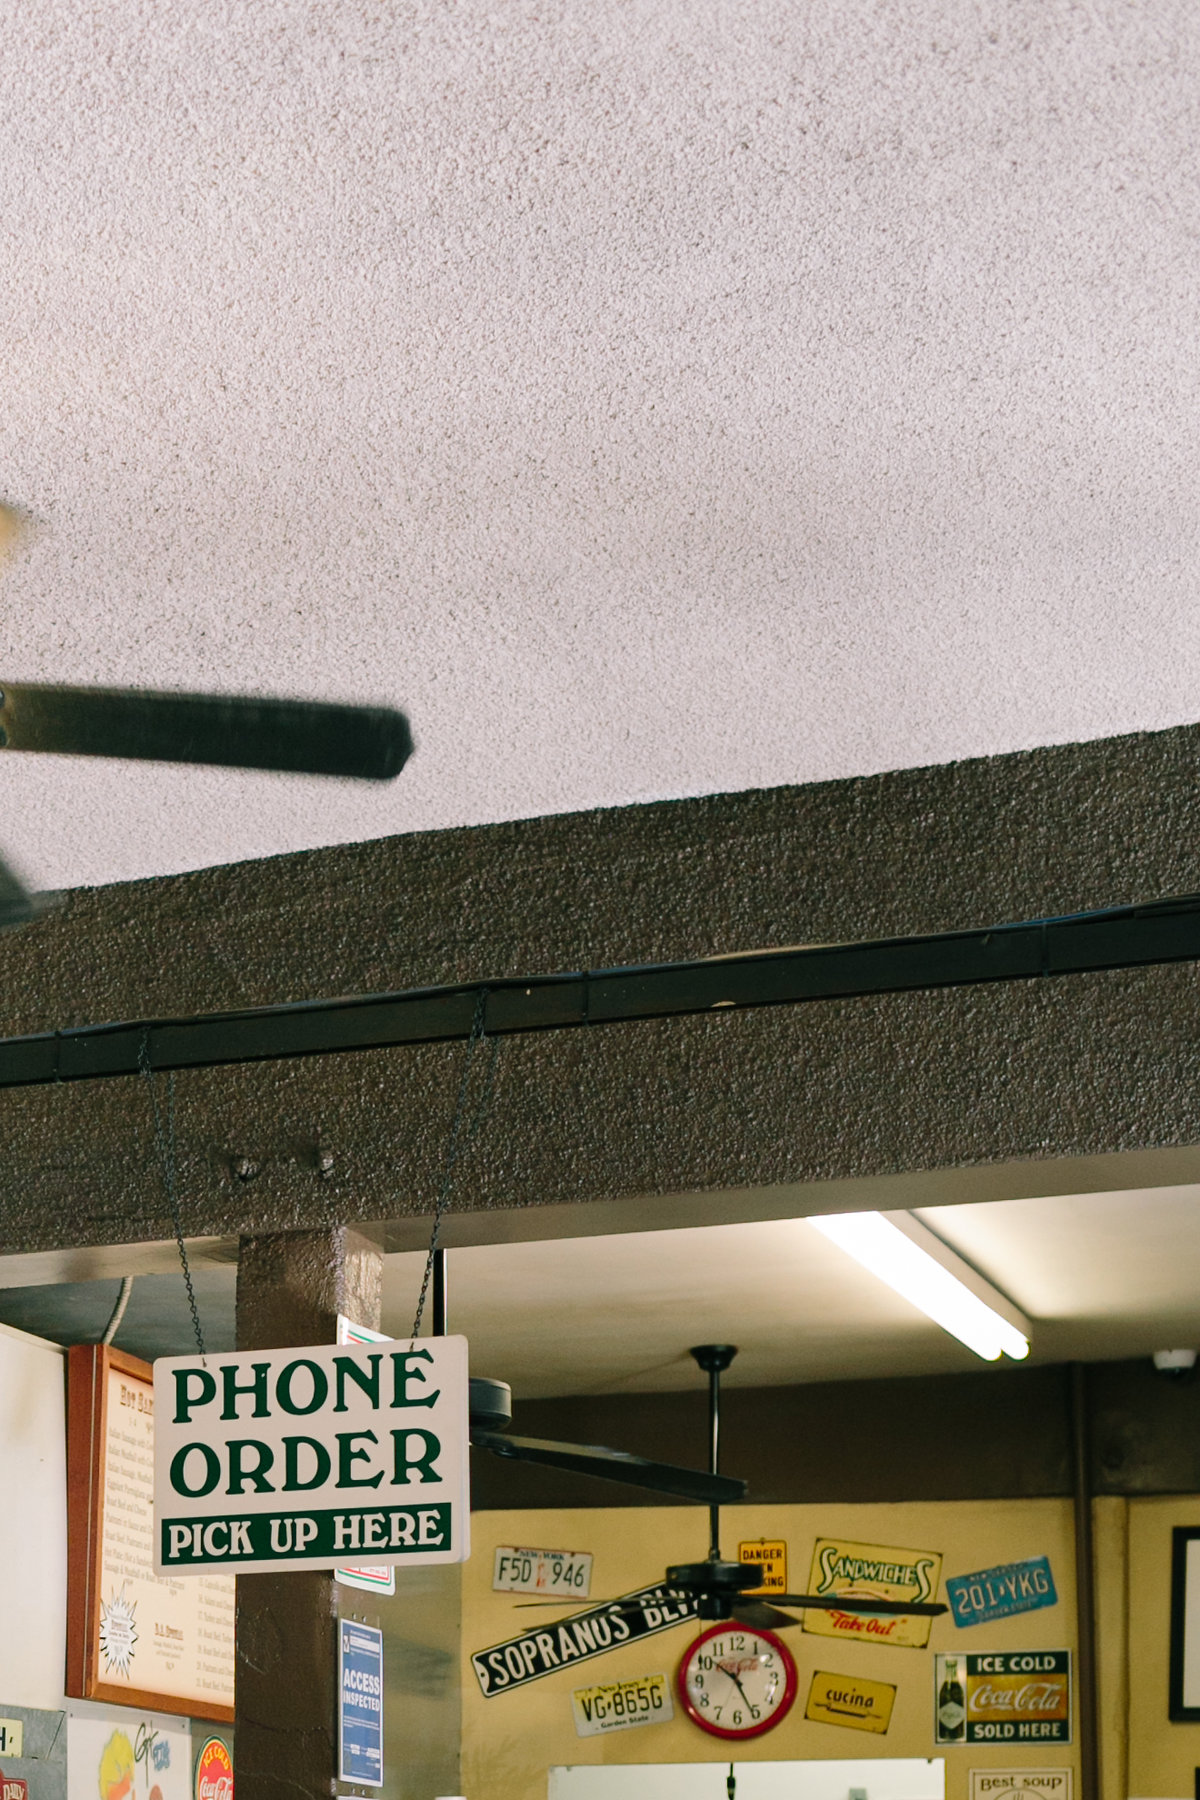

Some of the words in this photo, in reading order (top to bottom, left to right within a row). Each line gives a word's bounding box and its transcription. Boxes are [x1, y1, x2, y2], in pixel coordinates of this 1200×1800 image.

[172, 1349, 441, 1424] PHONE
[169, 1428, 443, 1498] ORDER
[168, 1521, 254, 1558] PICK
[270, 1518, 318, 1553] UP
[333, 1509, 444, 1550] HERE
[743, 1549, 782, 1560] DANGER
[499, 1557, 532, 1582] F5D
[552, 1562, 584, 1587] 946
[817, 1547, 934, 1603] SANDWICHES
[713, 1643, 724, 1656] 11
[729, 1636, 745, 1651] 12
[977, 1657, 1004, 1672] ICE
[1009, 1656, 1056, 1671] COLD
[344, 1668, 380, 1696] ACCESS
[343, 1692, 380, 1712] INSPECTED
[701, 1693, 709, 1707] 8
[826, 1688, 874, 1708] cucina
[969, 1682, 1062, 1712] Coca-Cola
[714, 1706, 723, 1720] 7
[733, 1711, 742, 1725] 6
[601, 1720, 627, 1728] Garden
[974, 1724, 1014, 1738] SOLD
[1019, 1723, 1061, 1737] HERE
[980, 1776, 1016, 1792] Best
[1023, 1777, 1062, 1790] soup
